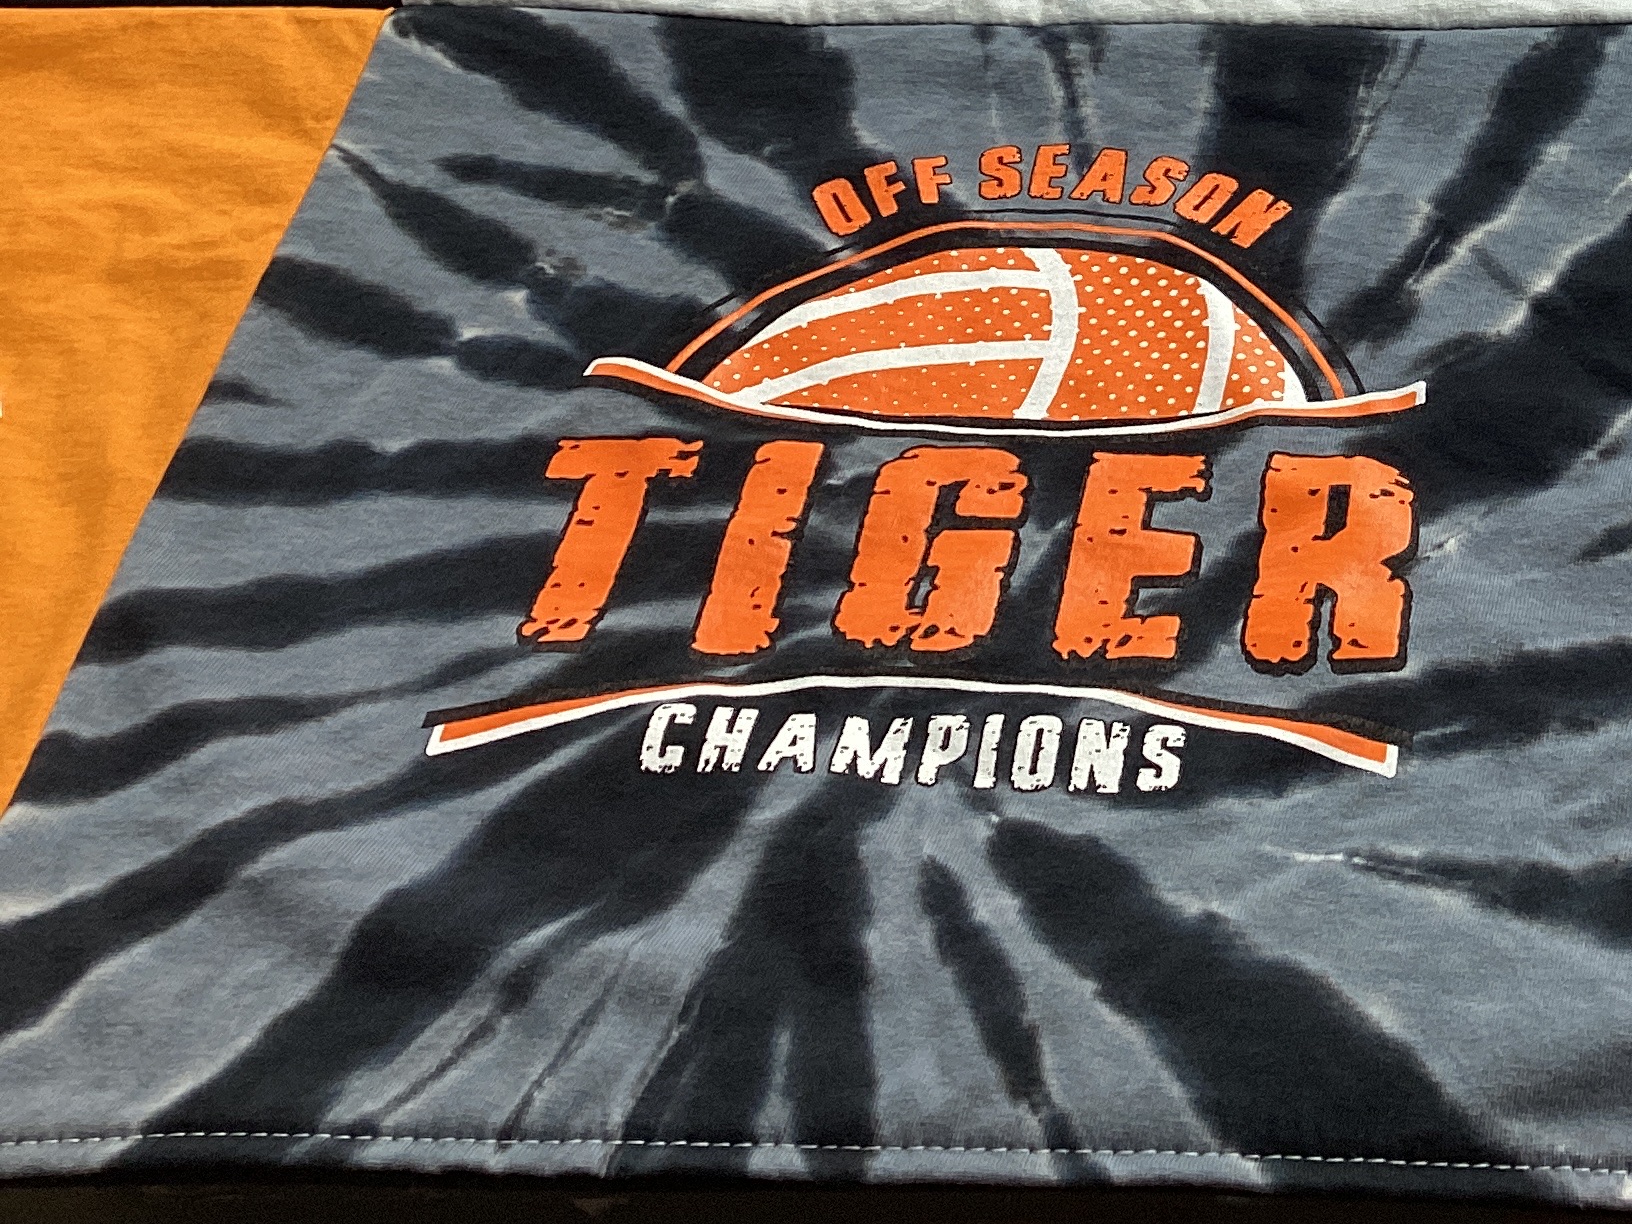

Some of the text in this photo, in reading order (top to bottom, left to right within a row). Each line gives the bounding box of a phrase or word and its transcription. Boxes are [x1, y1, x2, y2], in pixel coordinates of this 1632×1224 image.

[811, 141, 1295, 251] OFF SEASON
[518, 434, 1417, 674] TIGER
[638, 702, 1188, 794] CHAMPIONS
